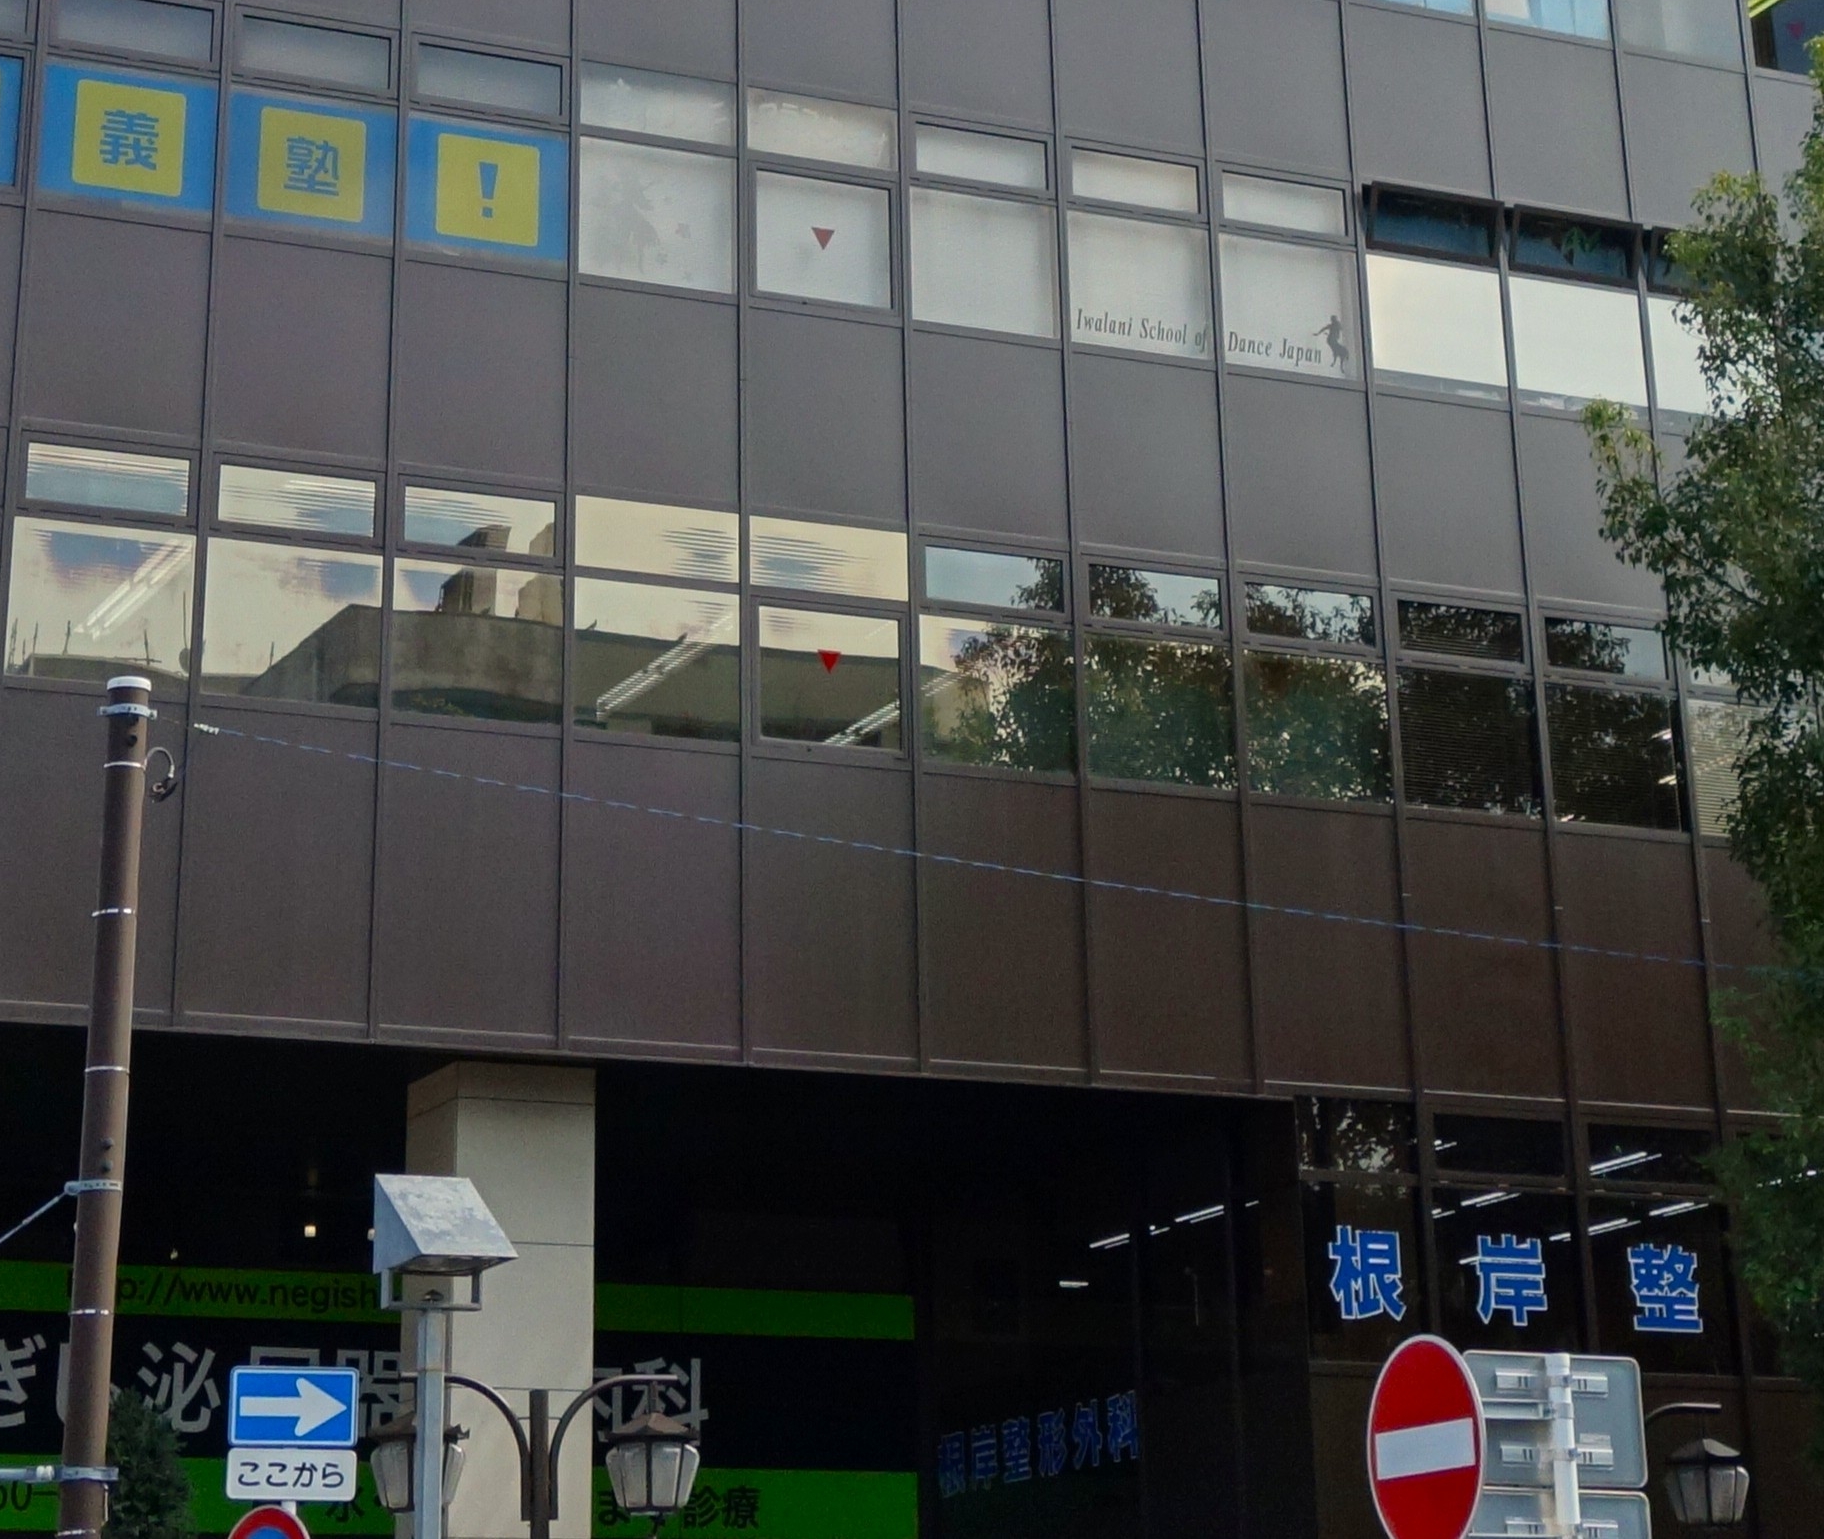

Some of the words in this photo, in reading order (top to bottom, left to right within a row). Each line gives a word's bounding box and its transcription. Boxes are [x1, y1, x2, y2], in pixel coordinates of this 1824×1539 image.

[1139, 318, 1188, 346] School
[1194, 327, 1209, 353] of
[1228, 331, 1272, 357] Dance
[1279, 337, 1322, 367] Japan
[237, 1462, 344, 1488] ここから
